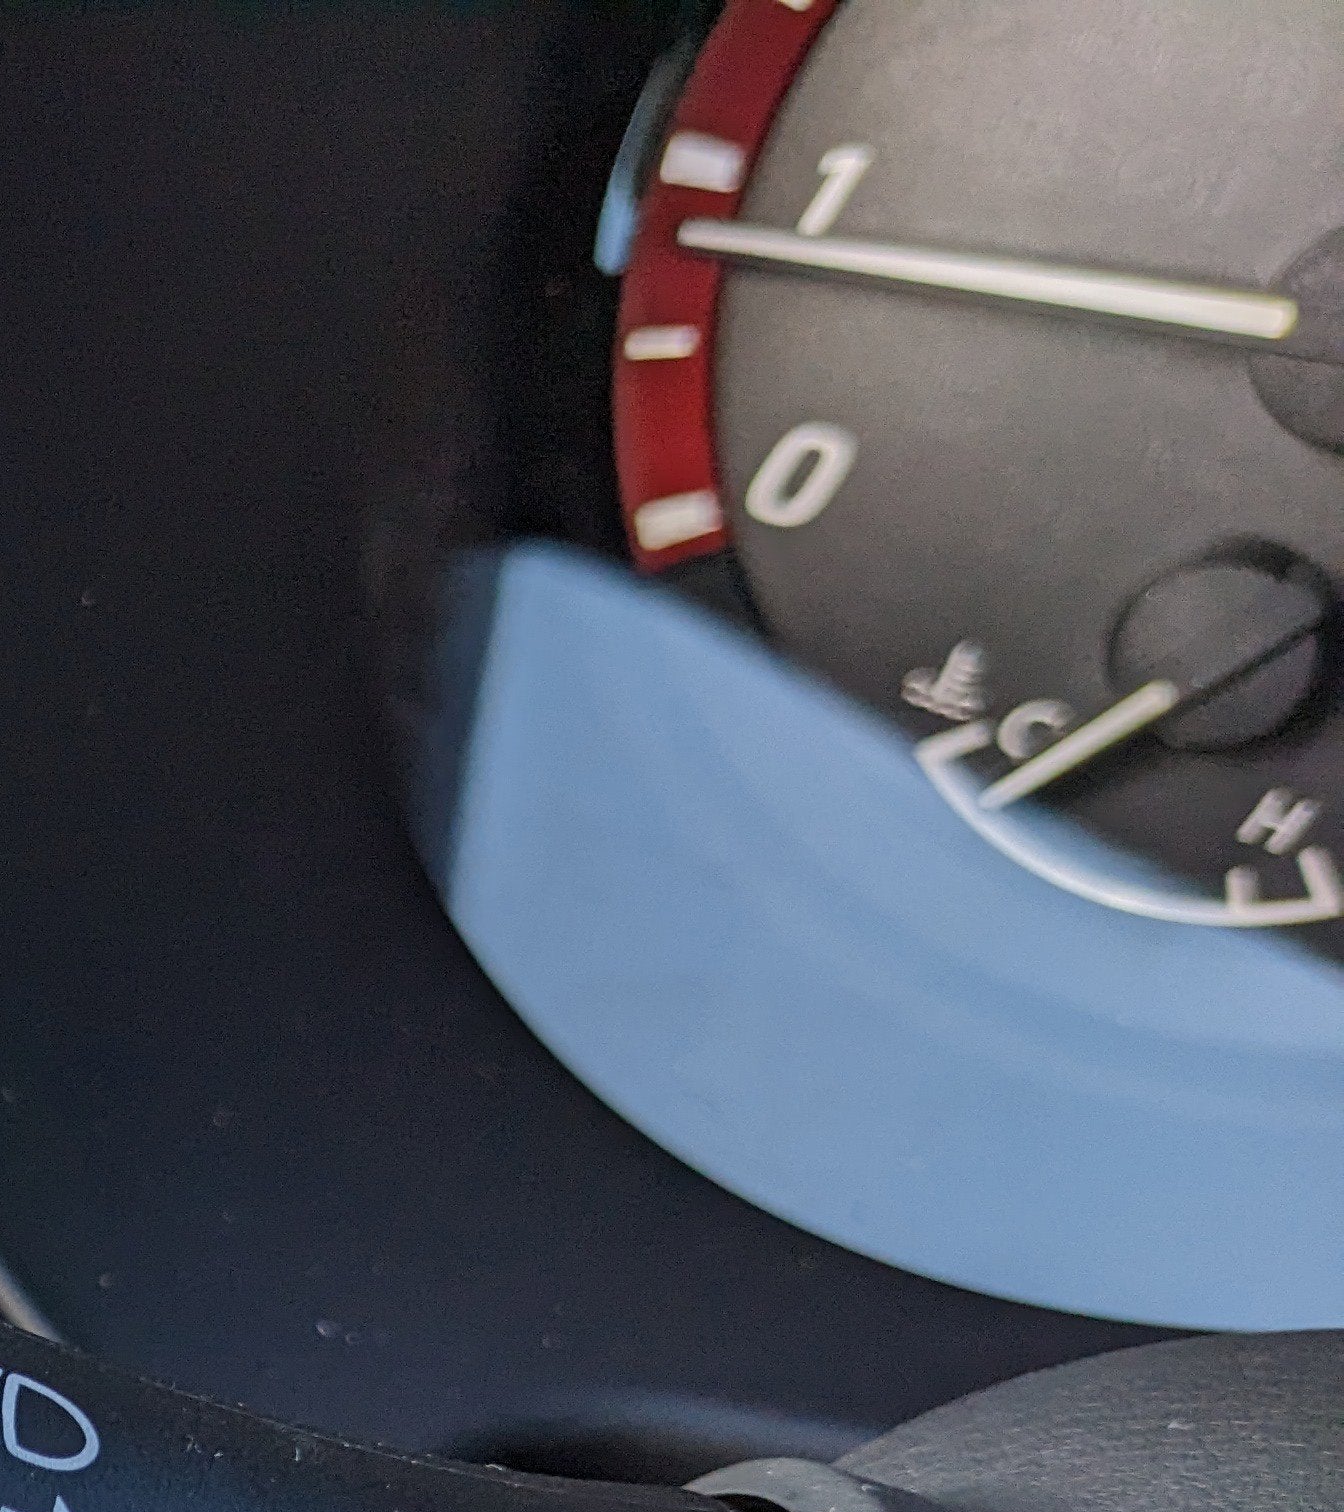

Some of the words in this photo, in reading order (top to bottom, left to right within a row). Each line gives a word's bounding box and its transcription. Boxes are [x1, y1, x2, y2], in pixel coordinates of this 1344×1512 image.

[797, 143, 876, 236] 1
[745, 421, 857, 527] 0
[997, 699, 1073, 762] C
[1237, 788, 1322, 855] H
